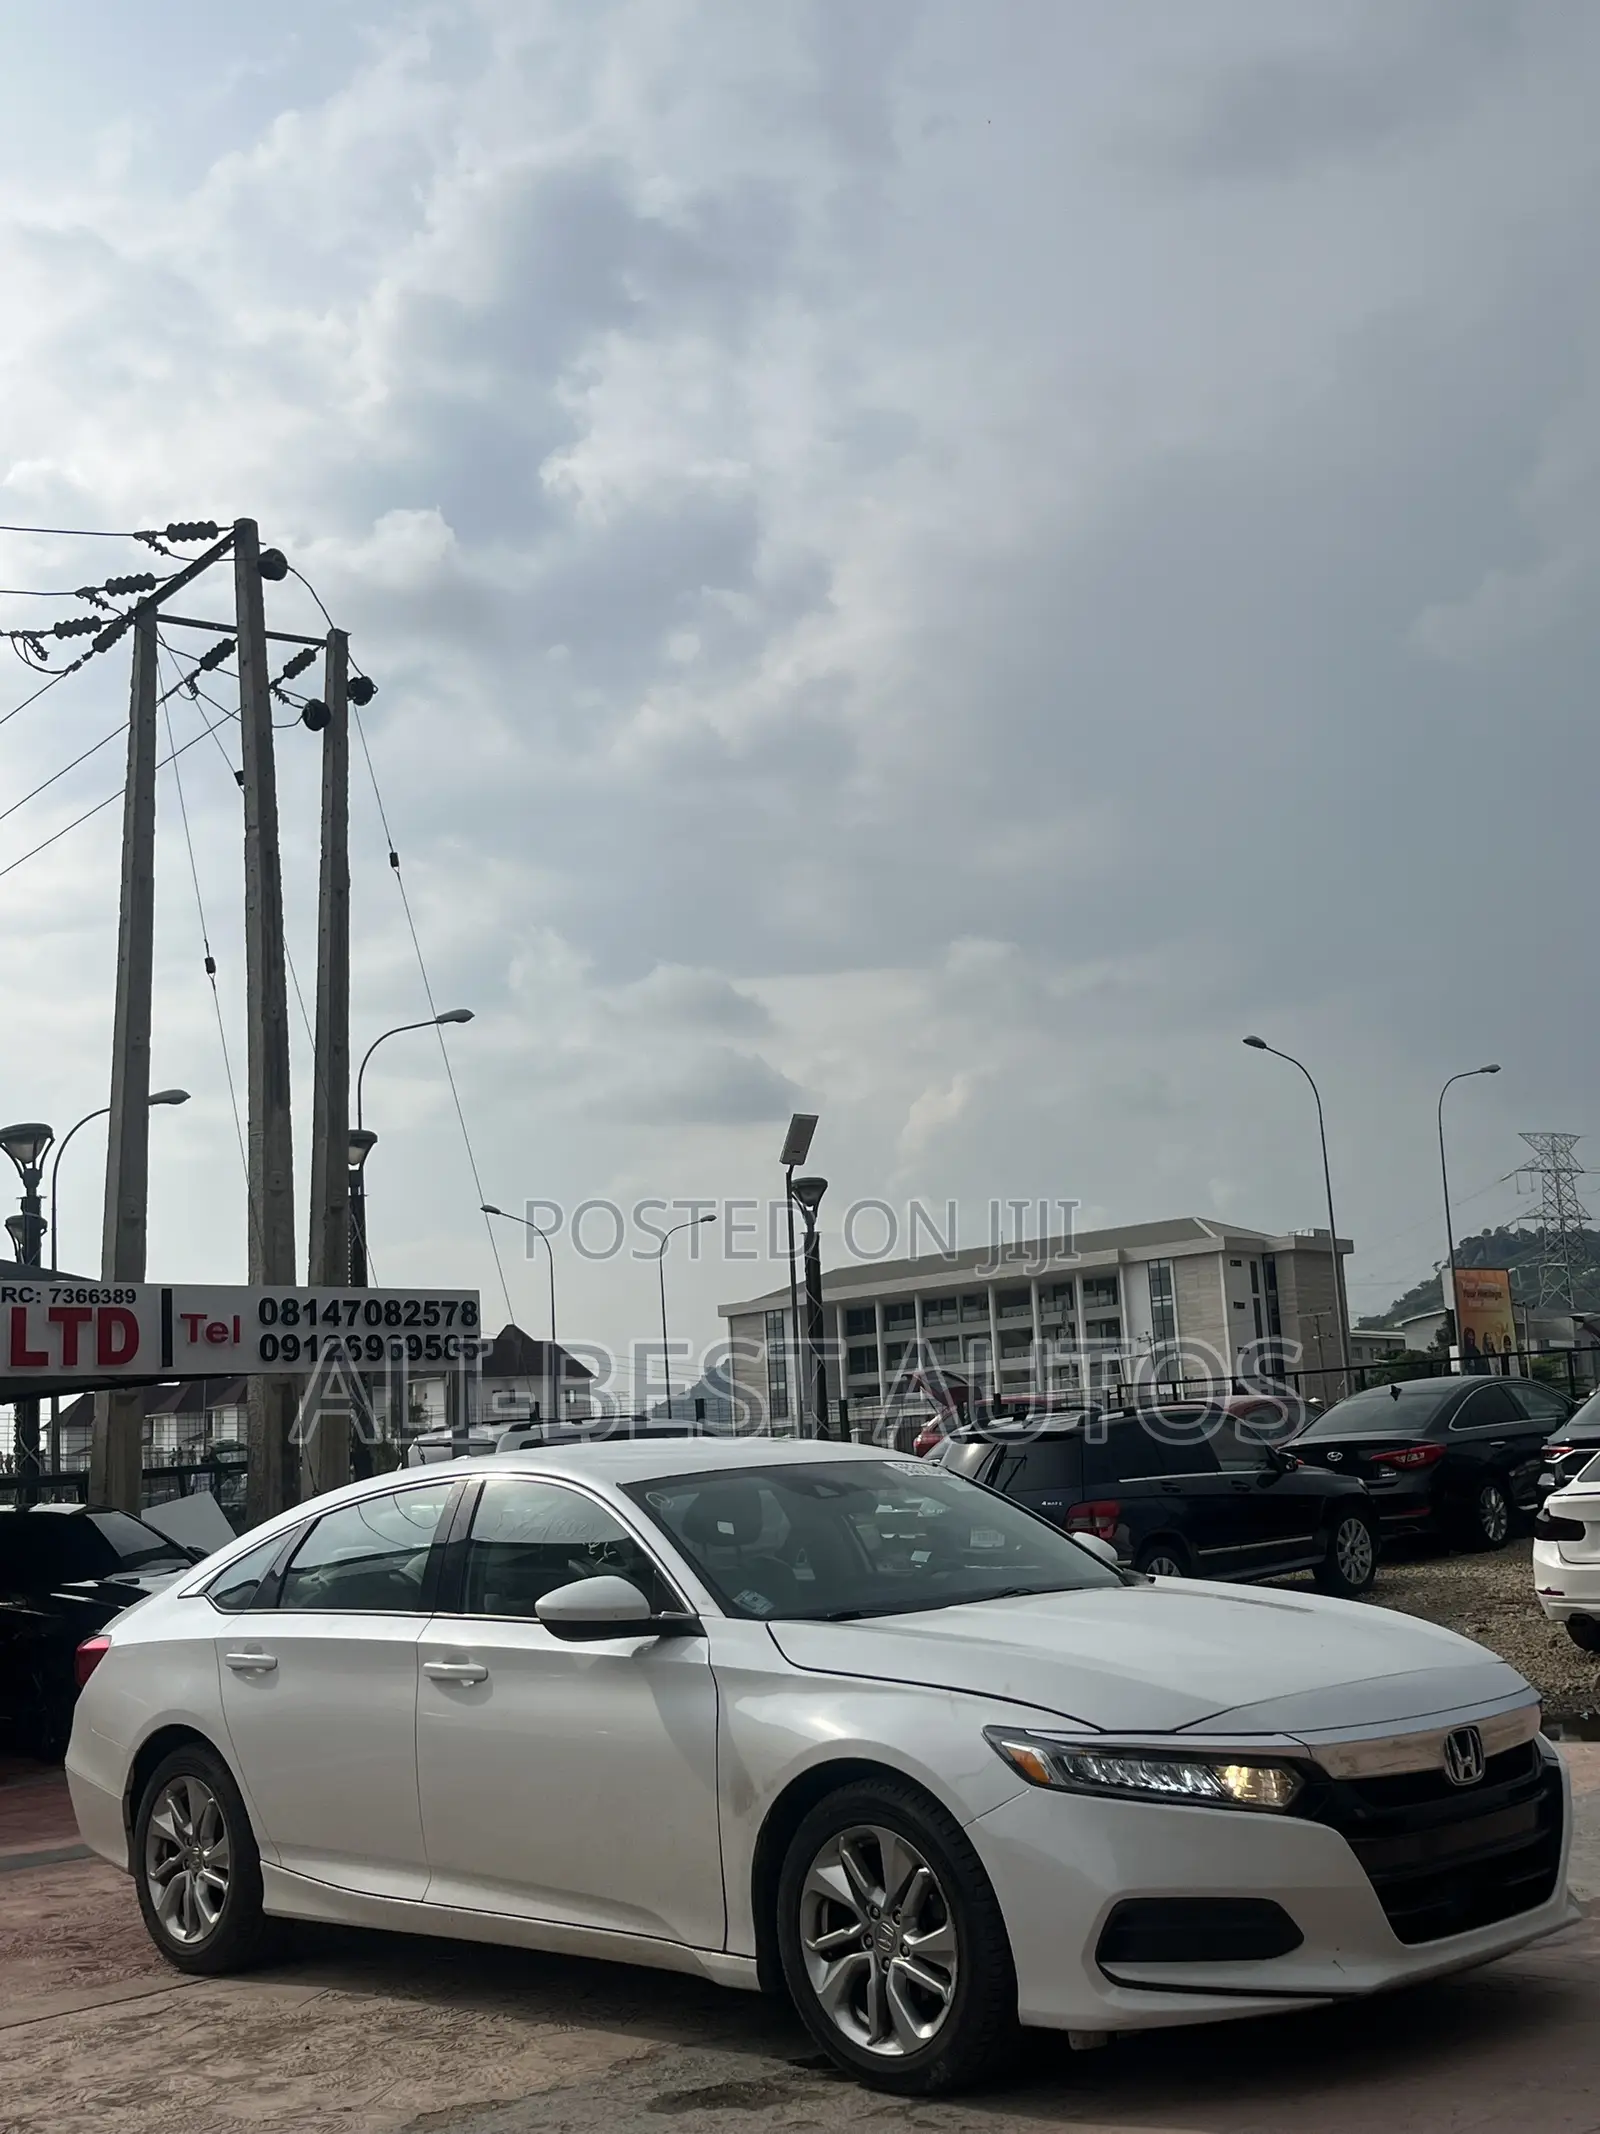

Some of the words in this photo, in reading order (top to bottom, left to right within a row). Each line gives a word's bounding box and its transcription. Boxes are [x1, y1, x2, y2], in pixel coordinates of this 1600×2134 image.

[1, 1286, 41, 1304] RC:
[49, 1287, 137, 1305] 7366389
[258, 1297, 478, 1327] 08147082578
[10, 1306, 139, 1367] LTD
[180, 1313, 240, 1344] Tel
